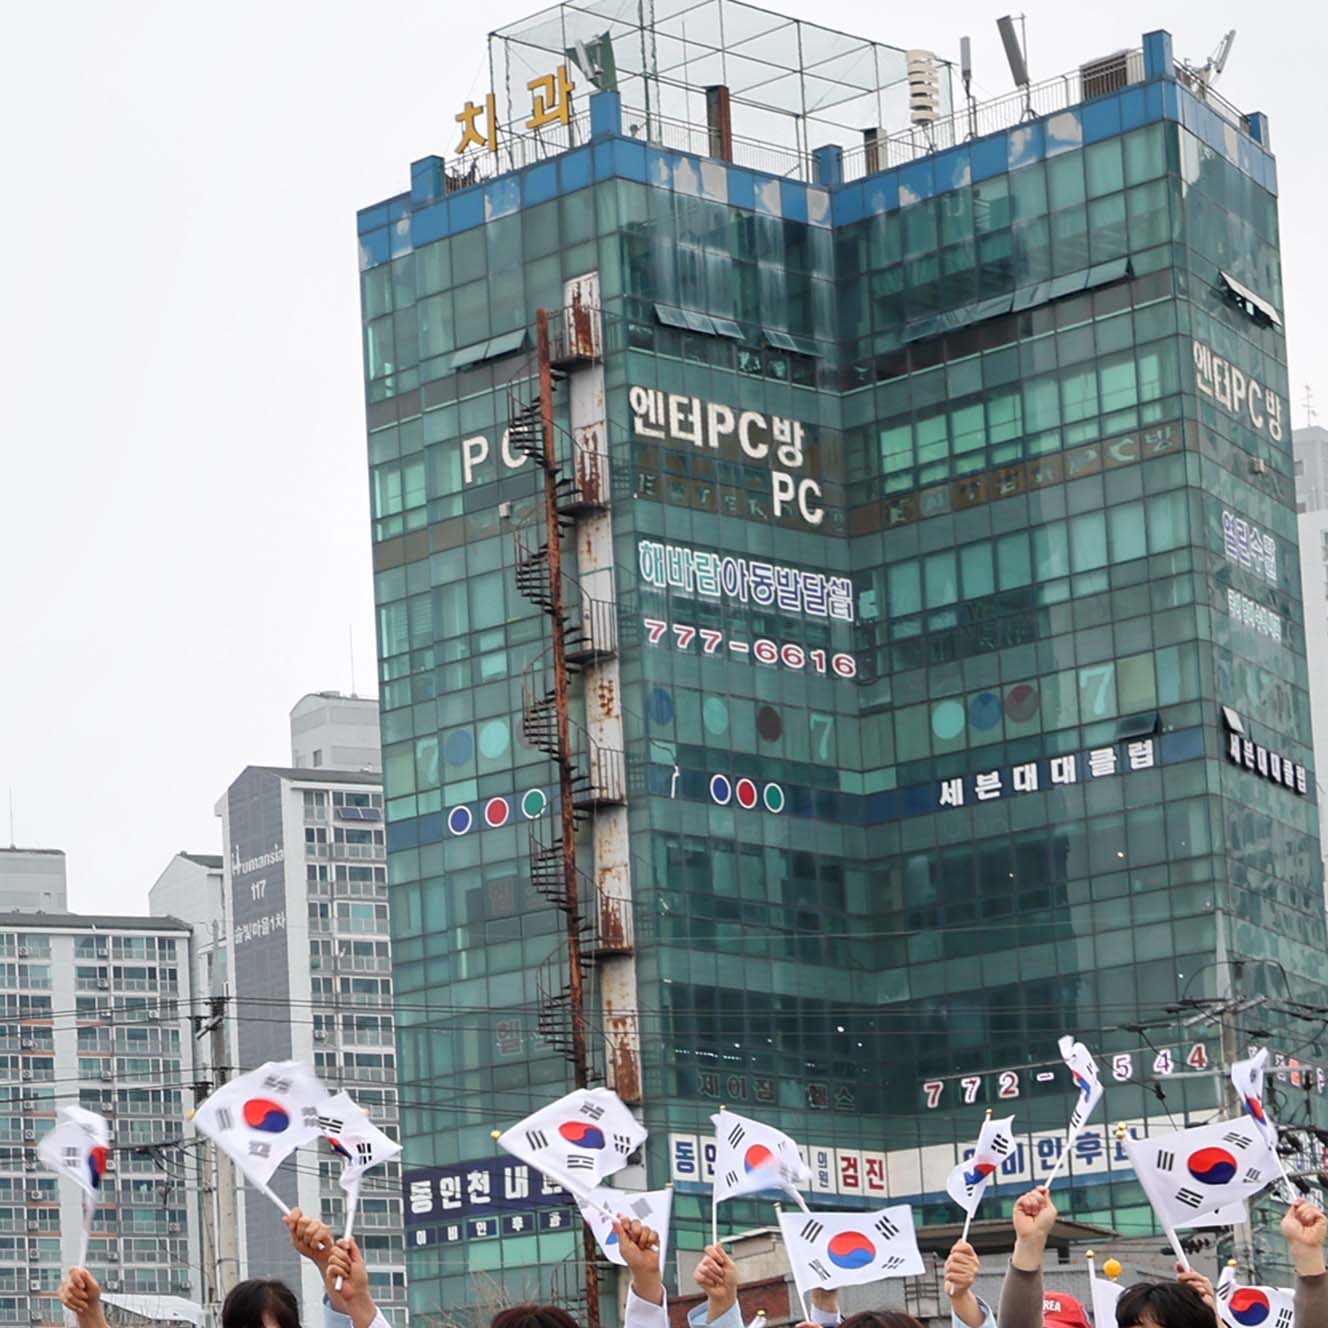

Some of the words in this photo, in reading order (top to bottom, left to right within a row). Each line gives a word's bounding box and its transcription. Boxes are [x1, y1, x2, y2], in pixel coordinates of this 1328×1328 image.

[454, 64, 575, 154] 치과
[1192, 340, 1282, 442] 엔터PC방
[462, 426, 529, 484] PC
[629, 386, 805, 467] 엔터PC방
[772, 471, 824, 525] PC
[644, 618, 857, 678] 777-6616
[939, 739, 1155, 807] 세븐대대클럽
[251, 880, 266, 901] 117
[923, 1043, 1208, 1108] 772-544
[840, 1155, 885, 1191] 검진
